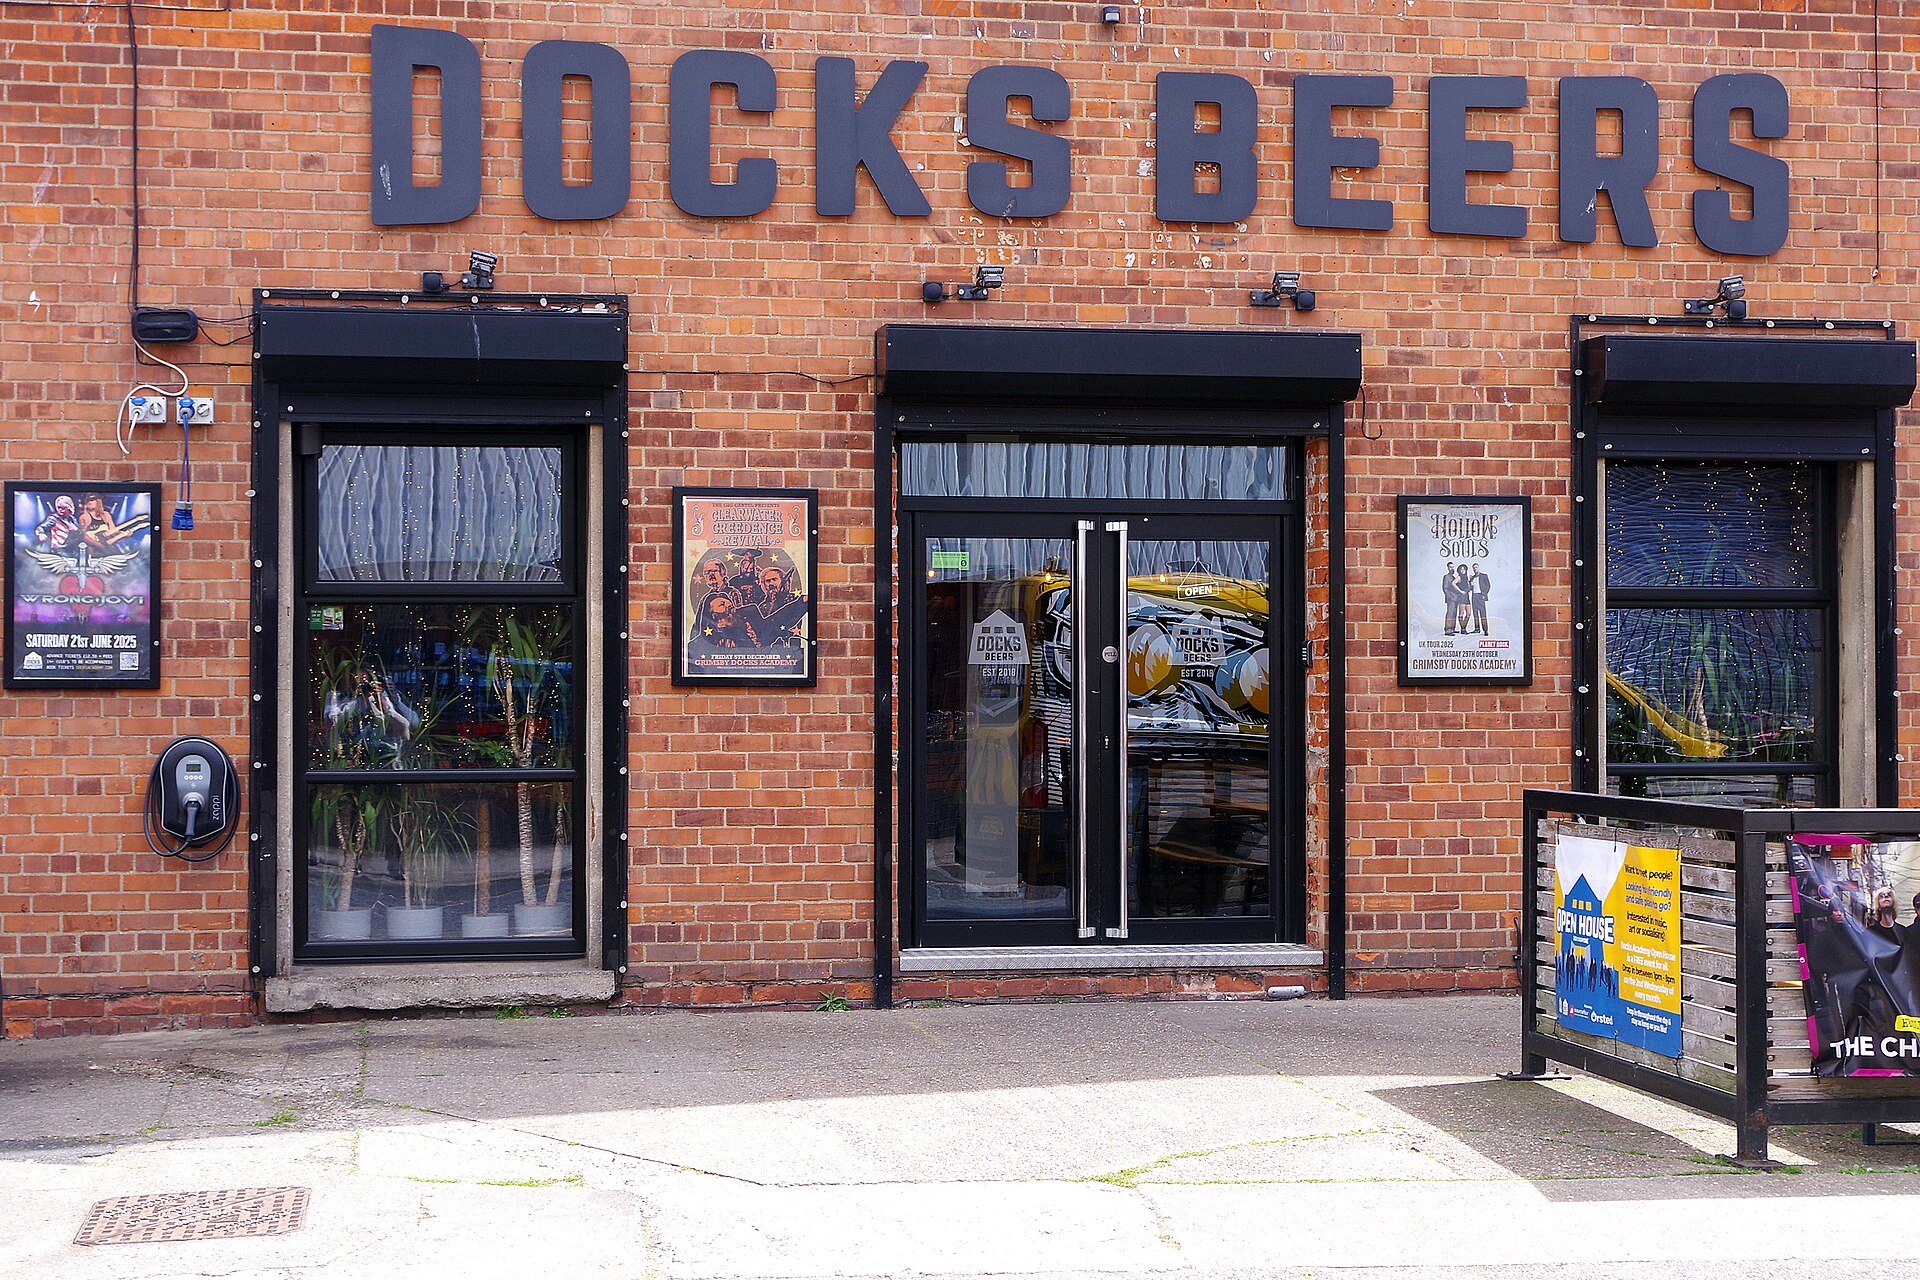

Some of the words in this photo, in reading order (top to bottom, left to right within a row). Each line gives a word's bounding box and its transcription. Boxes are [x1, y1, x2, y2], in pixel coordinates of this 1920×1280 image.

[371, 24, 1072, 226] DOCKS
[1156, 71, 1790, 257] BEERS
[712, 508, 783, 522] CLEARWATER
[712, 522, 783, 534] CREEDENCE
[724, 535, 770, 546] REVIVAL
[1184, 585, 1213, 597] OPEN
[26, 634, 70, 648] SATURDAY
[70, 634, 90, 648] 21ST
[90, 634, 112, 648] JUNE
[113, 635, 138, 649] 2025
[977, 636, 1021, 652] DOCKS
[1176, 637, 1220, 652] DOCKS
[985, 652, 1014, 660] BEERS
[1184, 654, 1212, 662] BEERS
[982, 668, 996, 676] EST
[1412, 660, 1449, 670] GRIMSBY
[1451, 660, 1477, 670] DOCKS
[1479, 660, 1516, 670] ACADEMY
[1181, 669, 1194, 678] EST
[1648, 870, 1673, 882] people?
[1626, 894, 1634, 903] and
[1658, 902, 1672, 912] go?
[1626, 910, 1649, 924] Interested
[1557, 908, 1577, 934] OPEN
[1579, 914, 1614, 943] HOUSE
[1622, 964, 1631, 974] Drop
[1636, 966, 1653, 979] between
[1830, 1036, 1874, 1058] THE
[1880, 1037, 1920, 1058] CH
